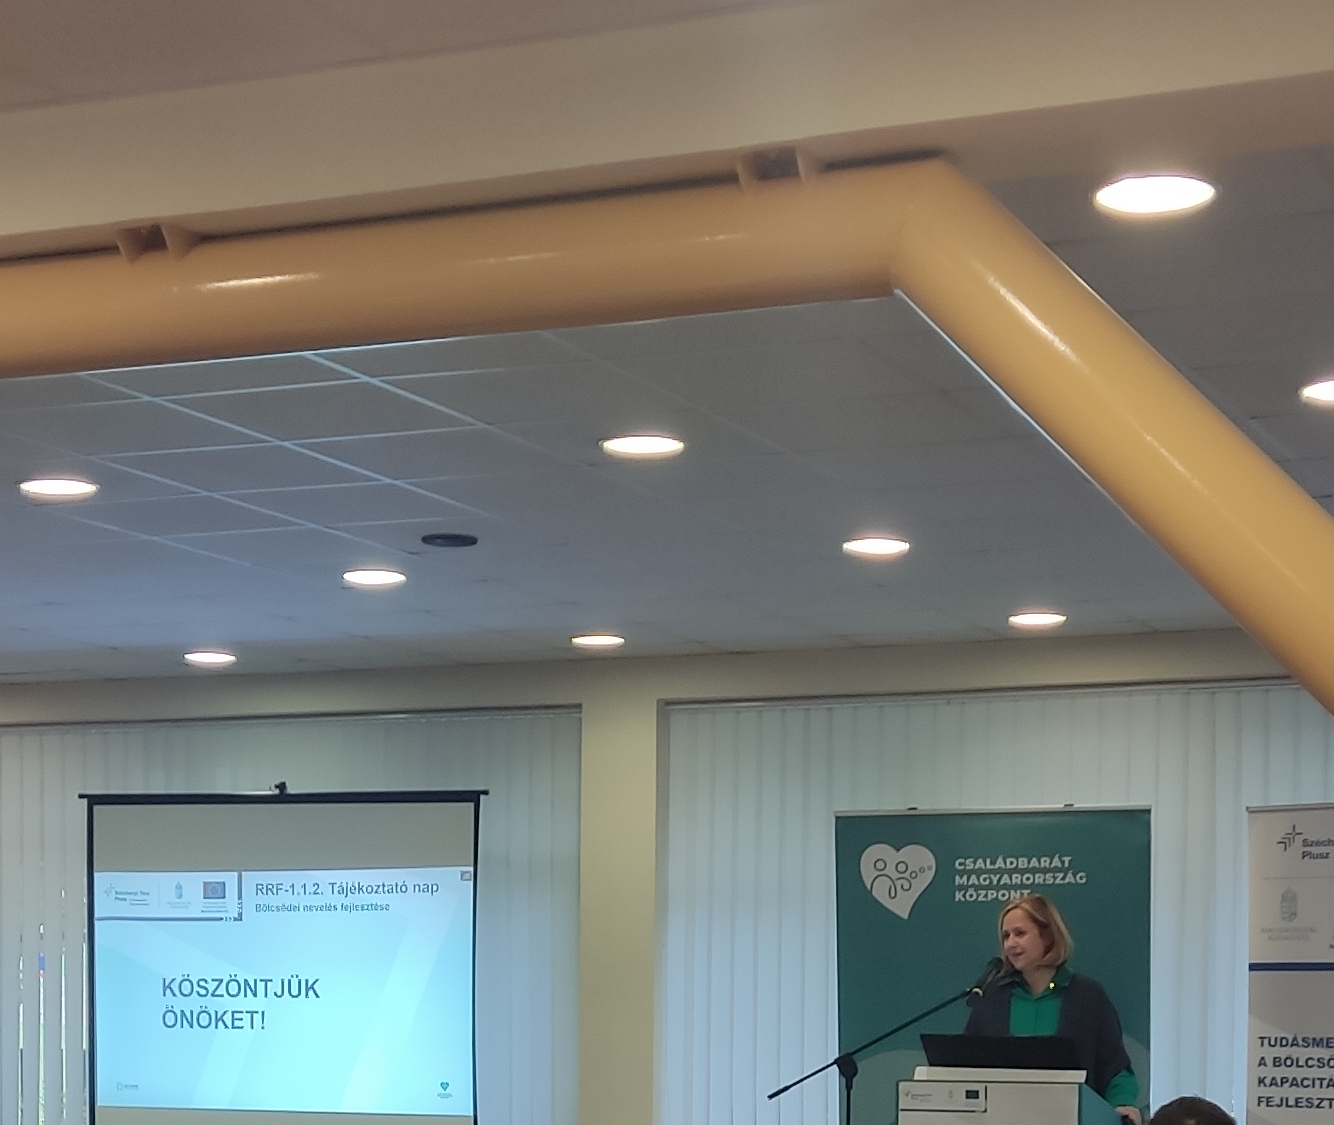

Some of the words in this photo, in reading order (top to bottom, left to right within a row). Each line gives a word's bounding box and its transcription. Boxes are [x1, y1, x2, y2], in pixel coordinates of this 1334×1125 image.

[955, 855, 1072, 869] CSALÁDBARÁT
[955, 871, 1087, 885] MAGYARORSZÁG
[255, 882, 324, 896] RRF-1.1.2.
[328, 881, 408, 898] Tájékoztató
[412, 882, 440, 896] nap
[161, 973, 321, 999] KÖSZÖNTJÜK
[161, 1004, 266, 1030] ÖNÖKET!
[1258, 1056, 1268, 1068] A
